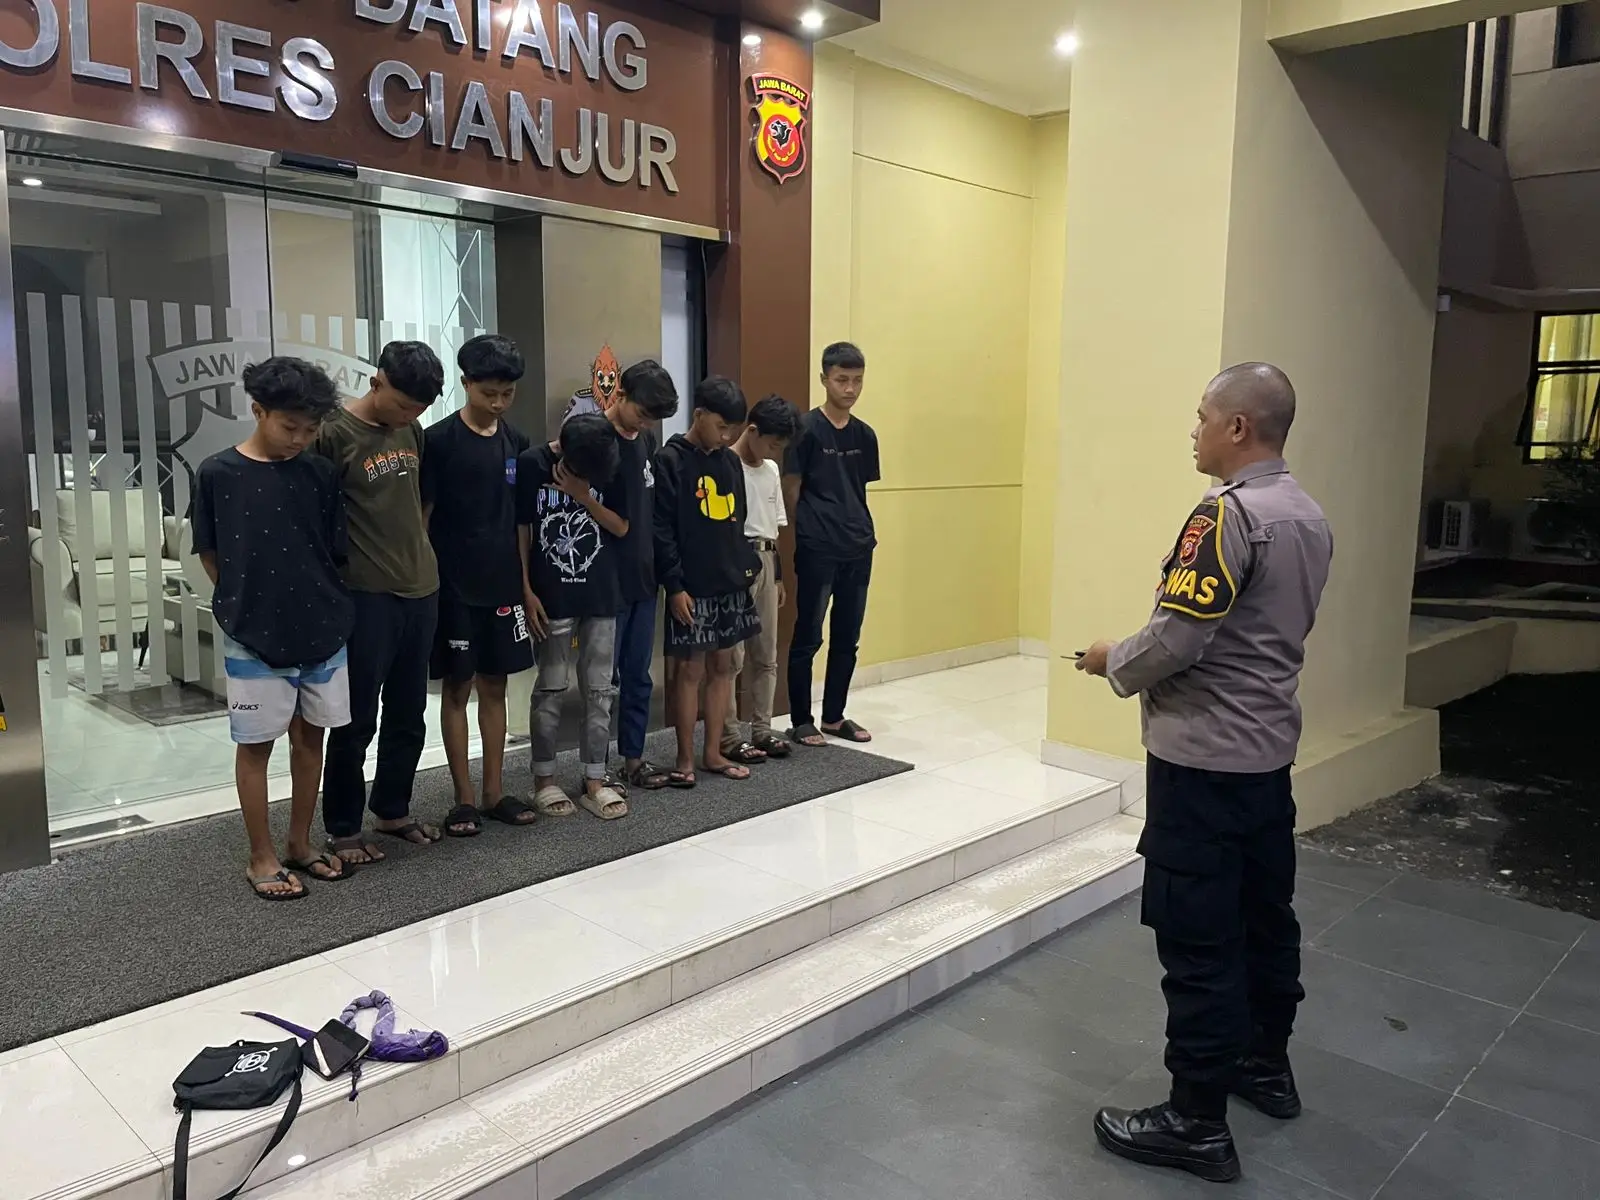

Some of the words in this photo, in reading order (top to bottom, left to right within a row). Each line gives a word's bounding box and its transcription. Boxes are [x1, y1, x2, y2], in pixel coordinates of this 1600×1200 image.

[355, 0, 648, 90] ATANG
[759, 79, 779, 88] JAWA
[780, 83, 805, 100] BARAT
[369, 60, 680, 193] CIANJUR
